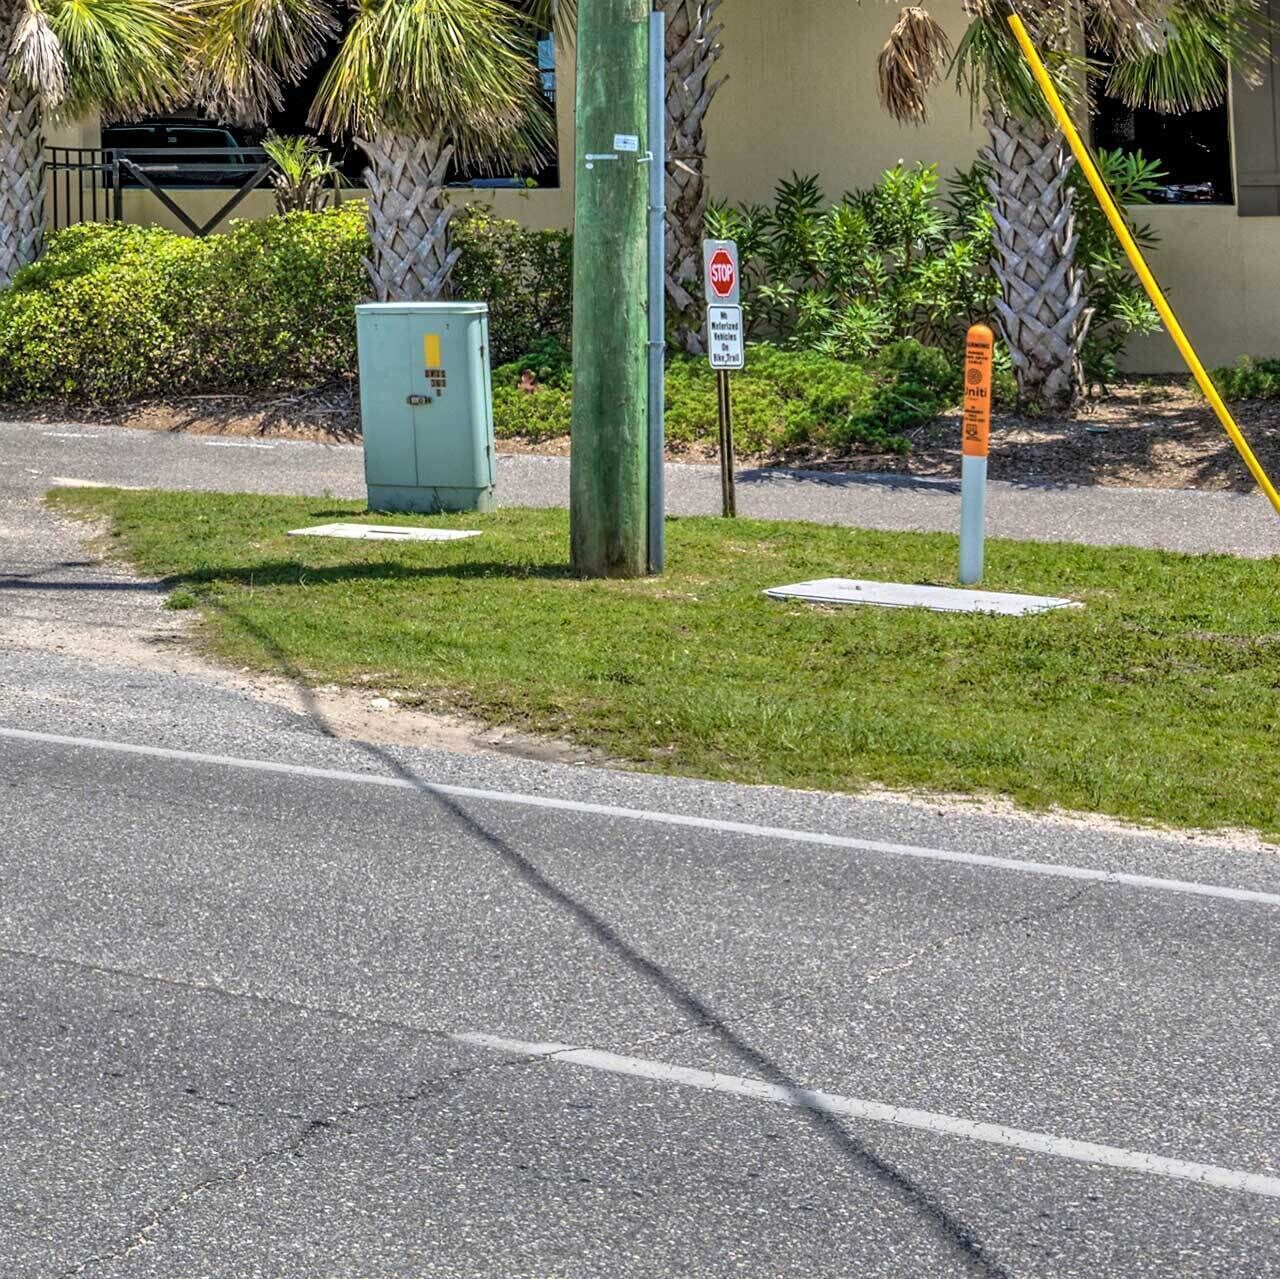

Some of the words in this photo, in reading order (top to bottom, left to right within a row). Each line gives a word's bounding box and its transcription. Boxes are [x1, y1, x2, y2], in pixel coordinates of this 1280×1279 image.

[711, 265, 734, 282] STOP
[711, 322, 739, 330] Motorized
[714, 332, 737, 341] Vehicles
[721, 343, 729, 351] On
[713, 353, 725, 362] Bike
[726, 353, 740, 362] Trail
